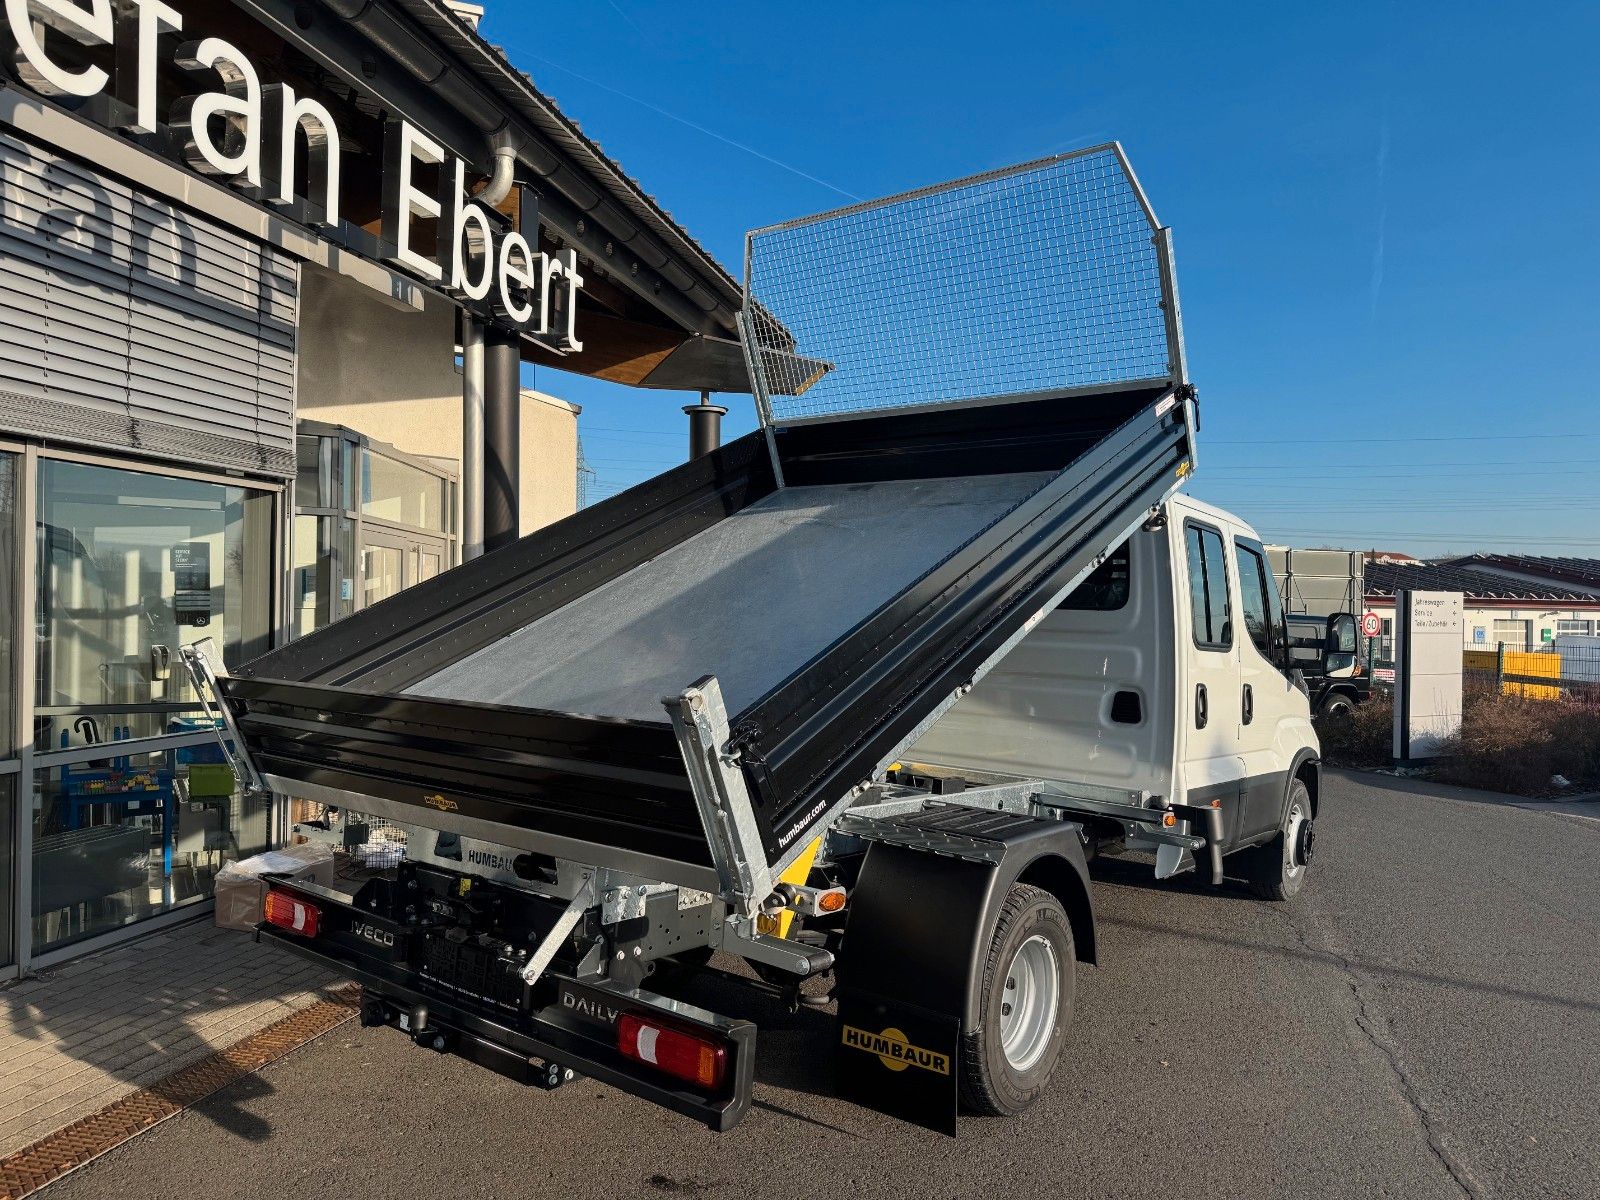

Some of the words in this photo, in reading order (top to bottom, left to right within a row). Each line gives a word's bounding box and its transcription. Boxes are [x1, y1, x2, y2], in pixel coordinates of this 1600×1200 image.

[397, 120, 583, 353] Ebert
[1366, 619, 1377, 630] 60
[778, 799, 827, 849] humbaur.com
[468, 849, 514, 873] HUMBAU
[351, 920, 394, 947] IVECO
[563, 991, 619, 1024] DAILY
[846, 1029, 946, 1073] HUMBAUR
